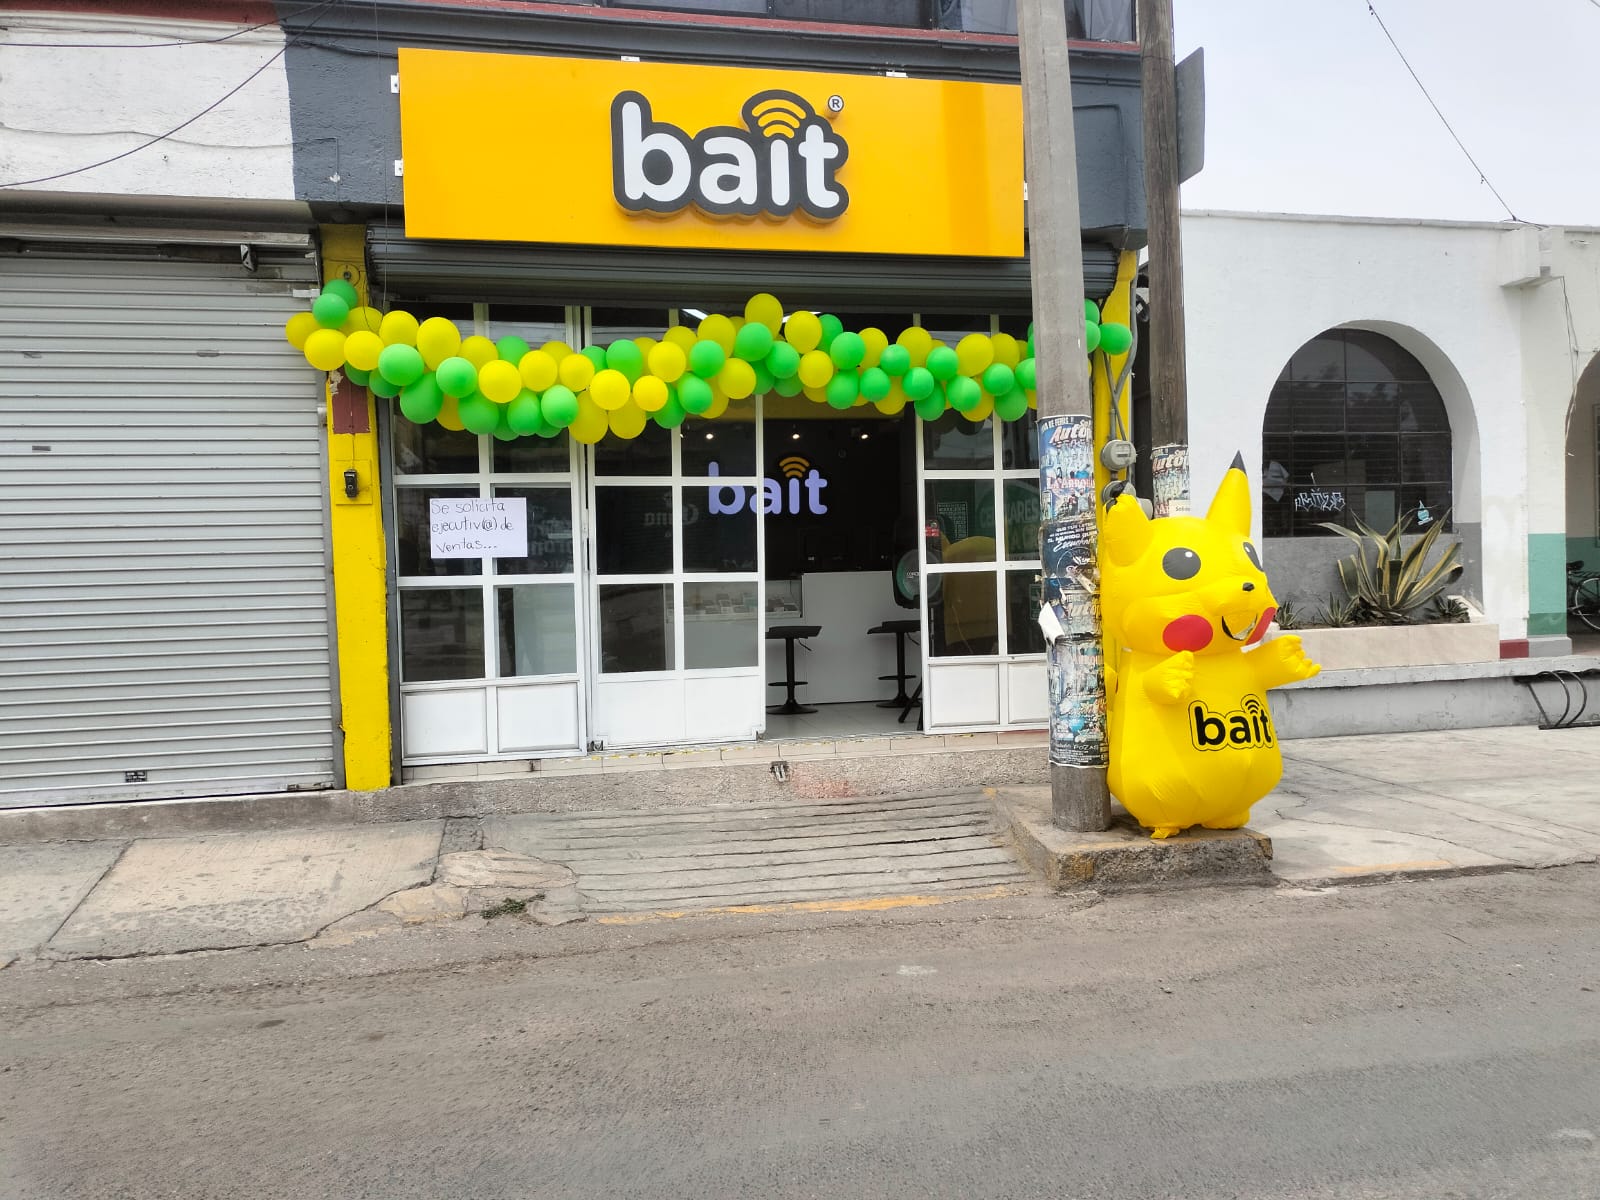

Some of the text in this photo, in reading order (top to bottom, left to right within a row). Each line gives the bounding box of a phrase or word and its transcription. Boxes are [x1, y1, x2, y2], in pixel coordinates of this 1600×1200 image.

[620, 99, 841, 210] bait
[431, 499, 505, 515] Se solicita
[708, 460, 828, 515] bait
[500, 517, 514, 531] de
[1194, 704, 1272, 746] bait
